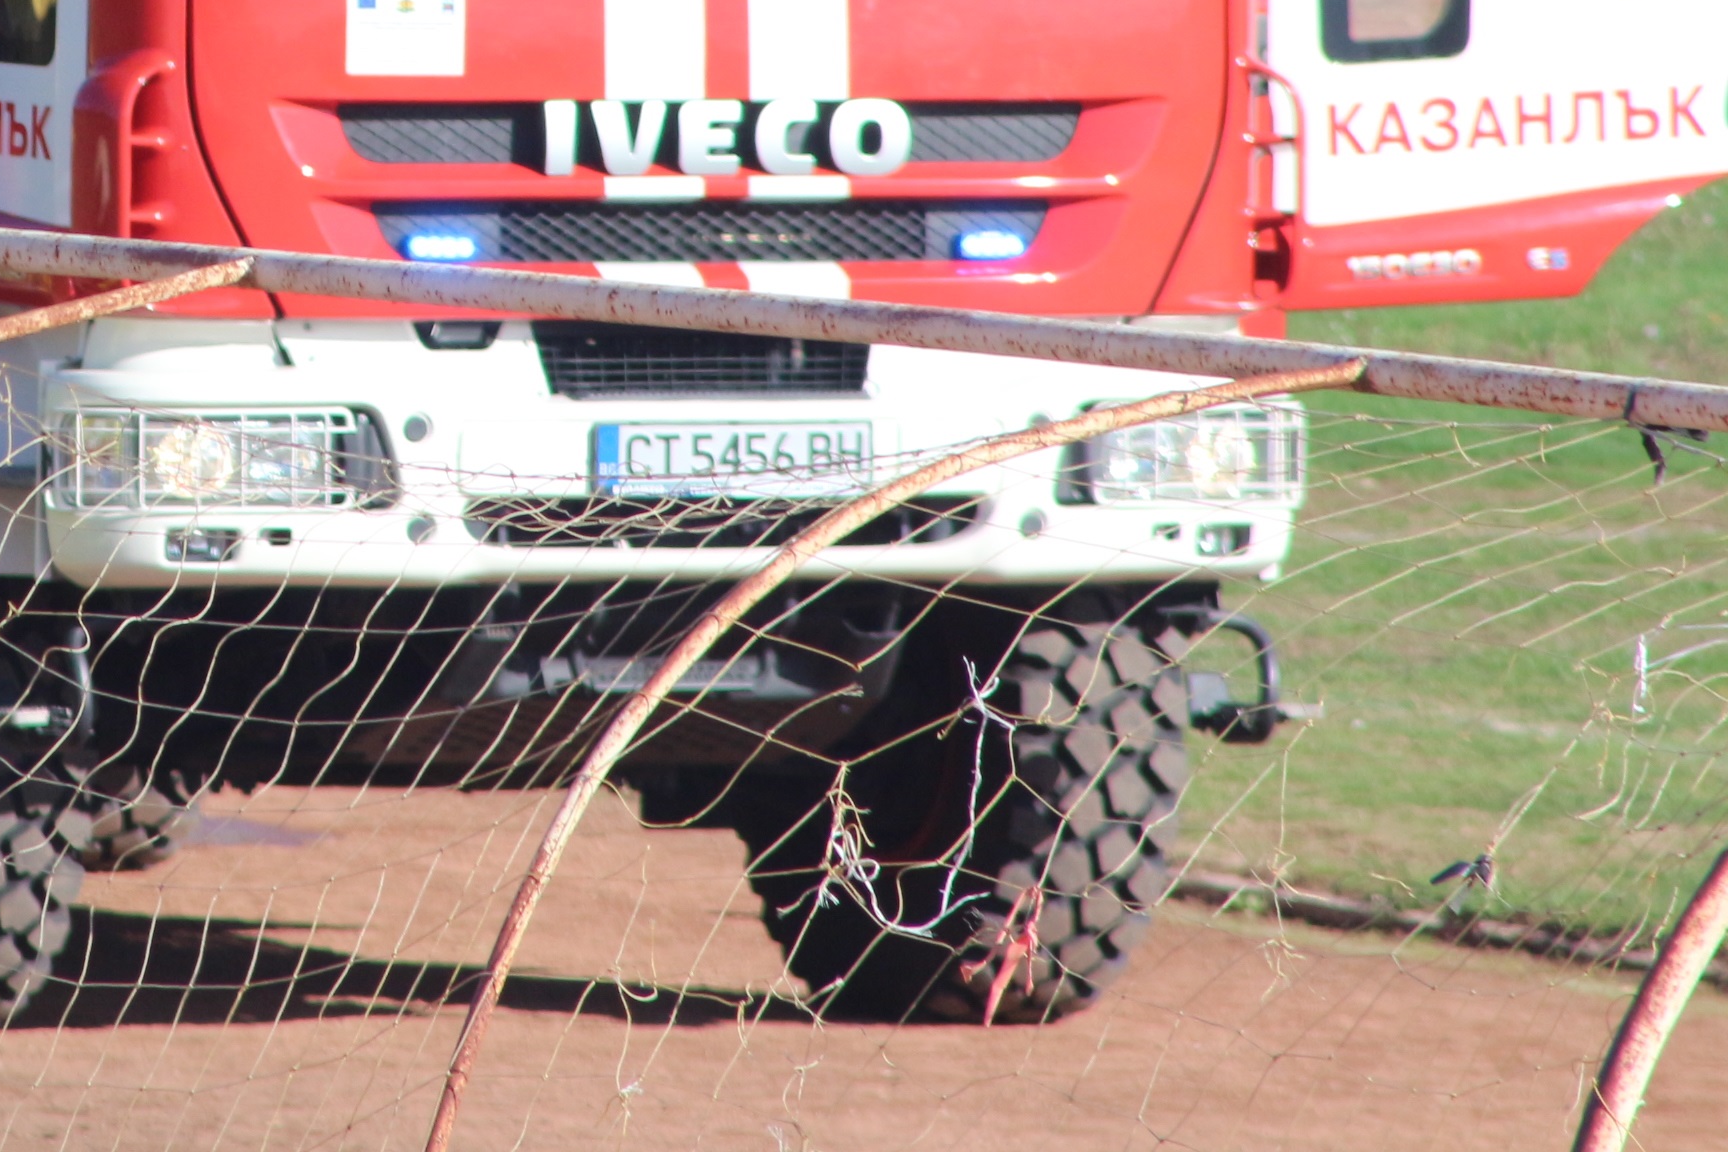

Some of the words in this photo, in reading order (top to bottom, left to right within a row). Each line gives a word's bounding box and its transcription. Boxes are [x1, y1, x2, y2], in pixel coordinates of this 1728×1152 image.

[543, 98, 913, 177] IVECO
[1328, 85, 1707, 157] КАЗАНЛЪК
[625, 433, 680, 477] CT
[690, 432, 796, 476] 5456
